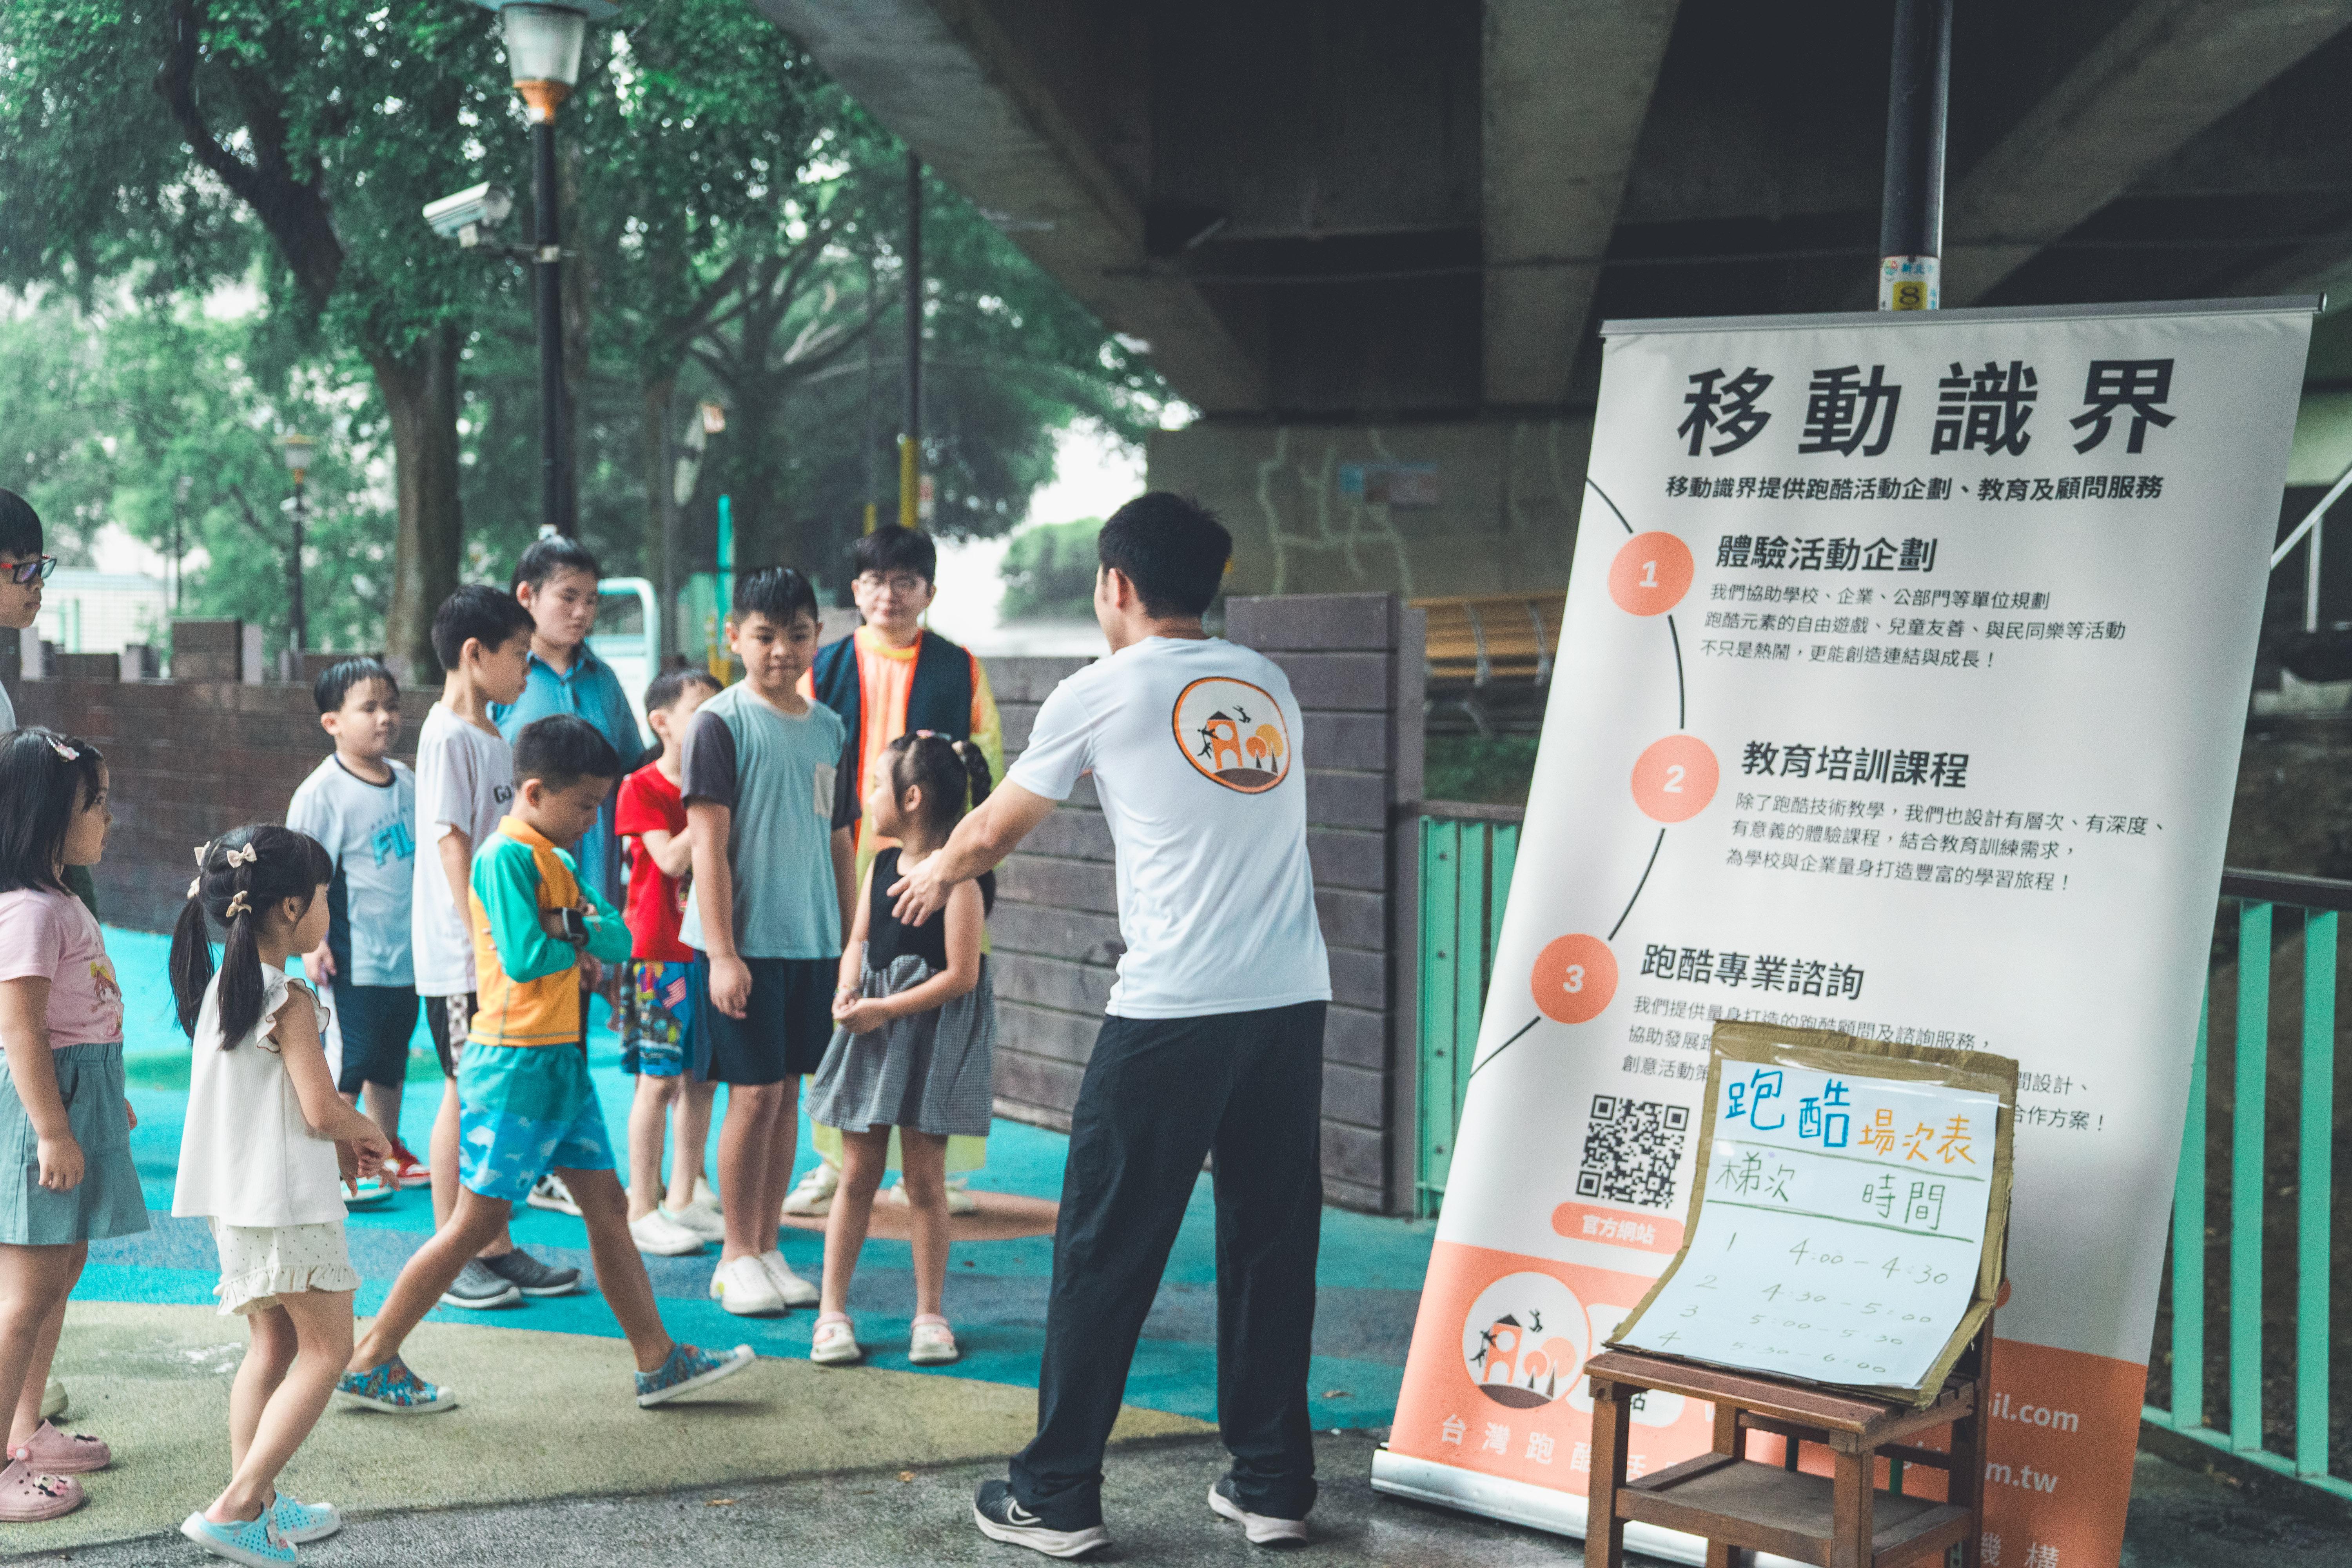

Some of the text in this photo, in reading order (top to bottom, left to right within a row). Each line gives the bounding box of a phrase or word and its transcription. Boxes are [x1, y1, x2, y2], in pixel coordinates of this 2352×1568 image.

[1677, 358, 2176, 457] 移動識界
[1665, 475, 2164, 501] 移動識界提供跑酷活動企劃、教育及顧問服務
[1716, 534, 1937, 572] 體驗活動企劃
[1639, 560, 1659, 587] 1
[1710, 583, 2050, 610] 我們協助學校、企業、公部門等單位規劃
[1704, 611, 2125, 641] 跑酷元素的自由遊戲、兒童友善、與民同樂等活動
[1741, 740, 1969, 788] 教育培訓課程
[1663, 765, 1685, 793] 2
[1563, 964, 1585, 993] 3
[1640, 943, 1864, 1000] 跑酷專業諮詢
[1862, 1174, 1945, 1230] 時間
[1583, 1214, 1656, 1244] 官方網站
[1727, 1232, 1737, 1251] 1
[1694, 1275, 1717, 1289] 2
[1679, 1305, 1699, 1318] 3
[1658, 1330, 1681, 1347] 4
[1989, 1392, 2078, 1433] il.com
